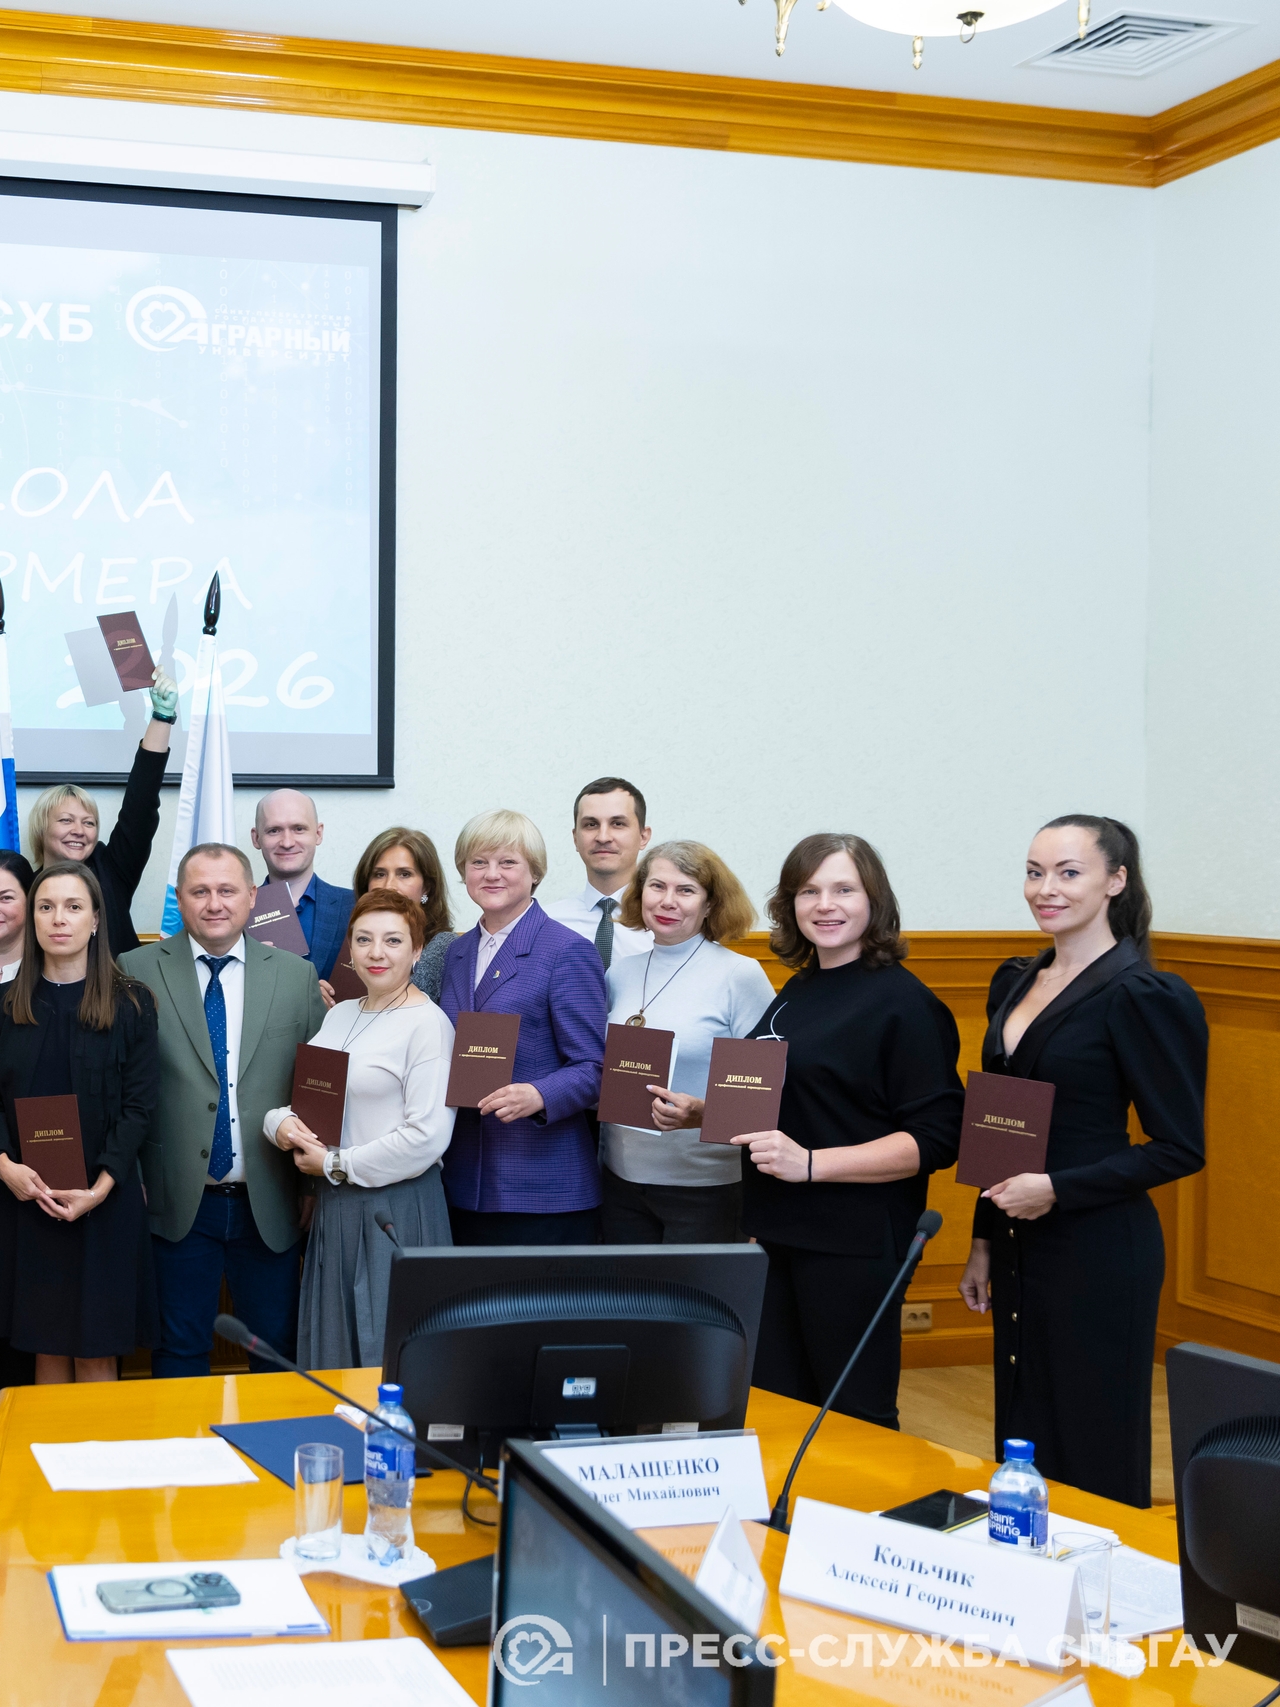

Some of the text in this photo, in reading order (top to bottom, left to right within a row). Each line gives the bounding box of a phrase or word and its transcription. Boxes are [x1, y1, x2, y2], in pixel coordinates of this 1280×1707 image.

[164, 322, 351, 352] АГРАРНЫЙ
[198, 345, 350, 362] УНИВЕРСИТЕТ
[468, 1045, 499, 1054] ДИПЛОМ
[619, 1060, 652, 1071] ДИПЛОМ
[306, 1077, 332, 1088] ДИПЛОМ
[725, 1074, 763, 1085] ДИПЛОМ
[983, 1114, 1026, 1129] ДИПЛОМ
[34, 1129, 64, 1139] ДИПЛОМ
[577, 1457, 720, 1481] МАЛАЩЕНКО
[627, 1485, 720, 1502] Михайлович
[873, 1543, 975, 1588] Кольчик
[825, 1563, 1017, 1628] Алексей Георгиевич
